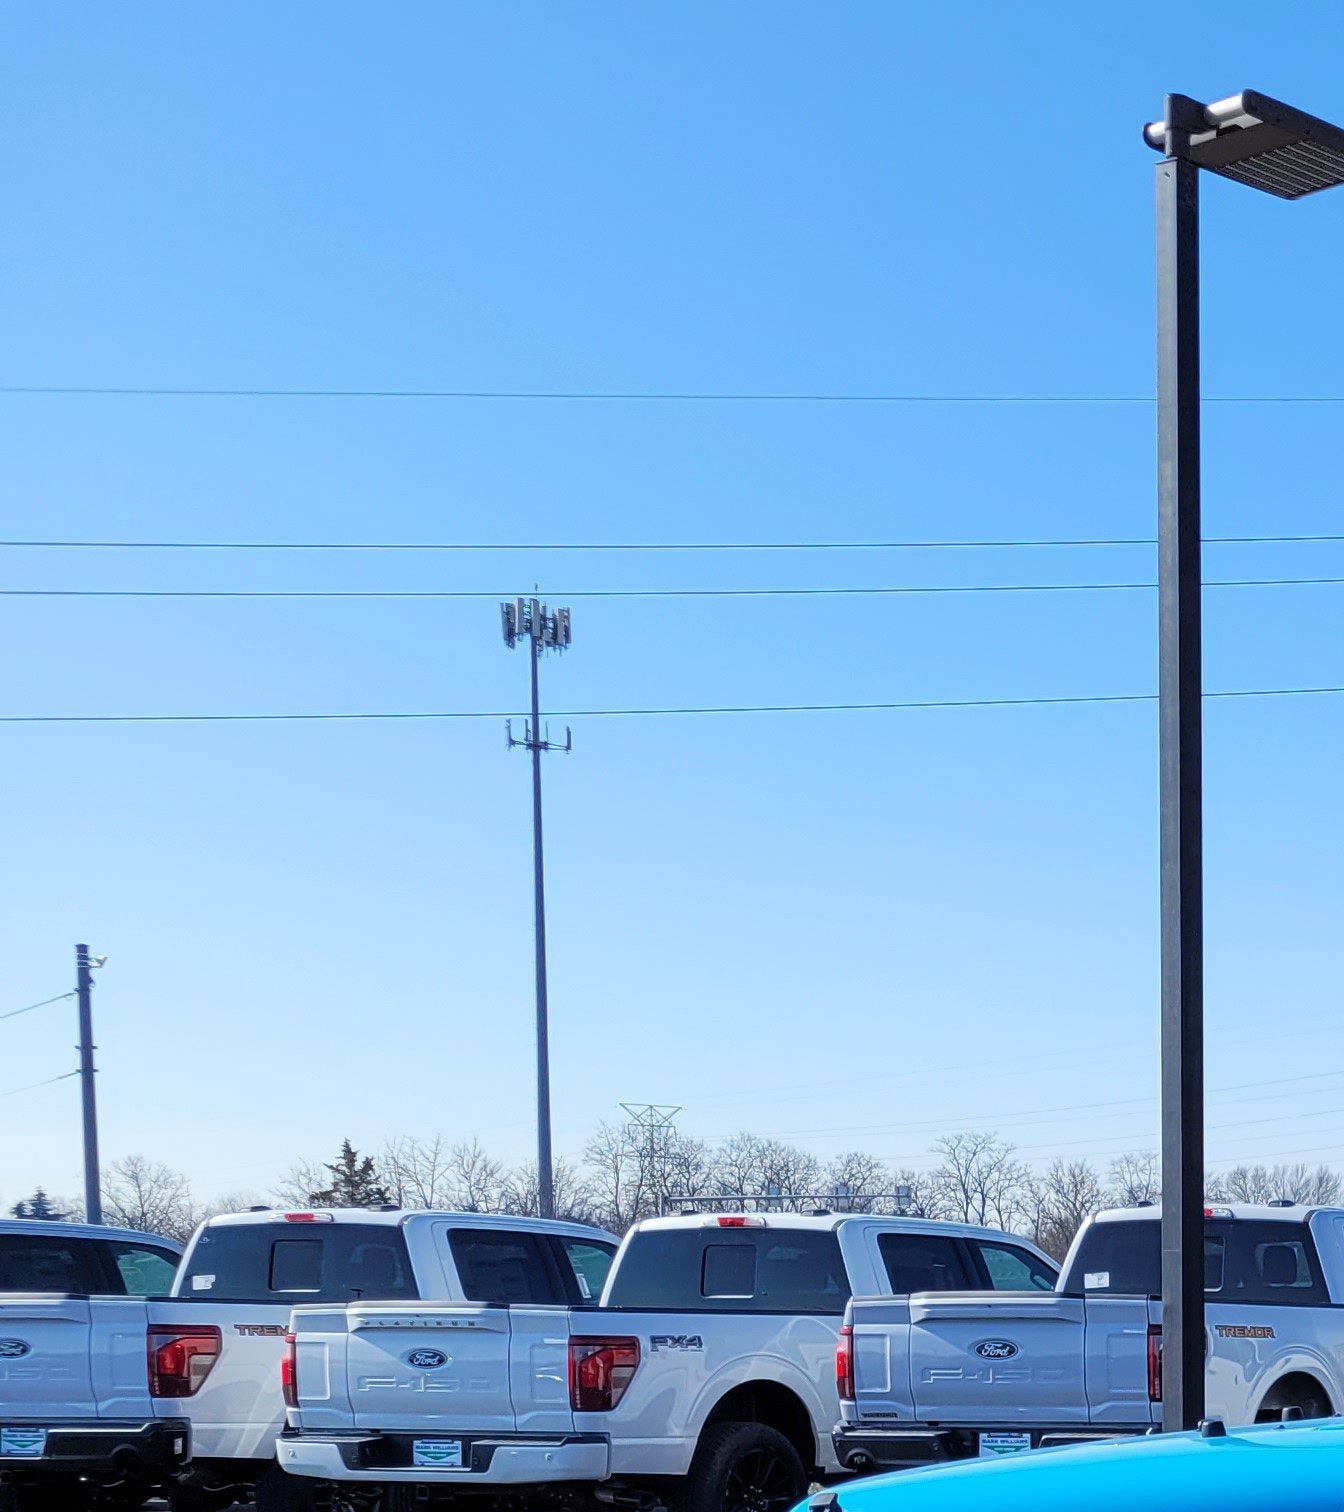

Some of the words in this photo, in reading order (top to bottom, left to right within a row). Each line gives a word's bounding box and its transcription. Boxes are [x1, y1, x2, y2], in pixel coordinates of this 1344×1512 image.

[233, 1324, 290, 1336] TREM
[1214, 1324, 1276, 1338] TREMOR
[649, 1335, 703, 1352] FX4
[979, 1342, 1012, 1357] Ford
[410, 1351, 441, 1367] Ford
[921, 1367, 1072, 1384] F-150
[357, 1375, 500, 1393] F-150
